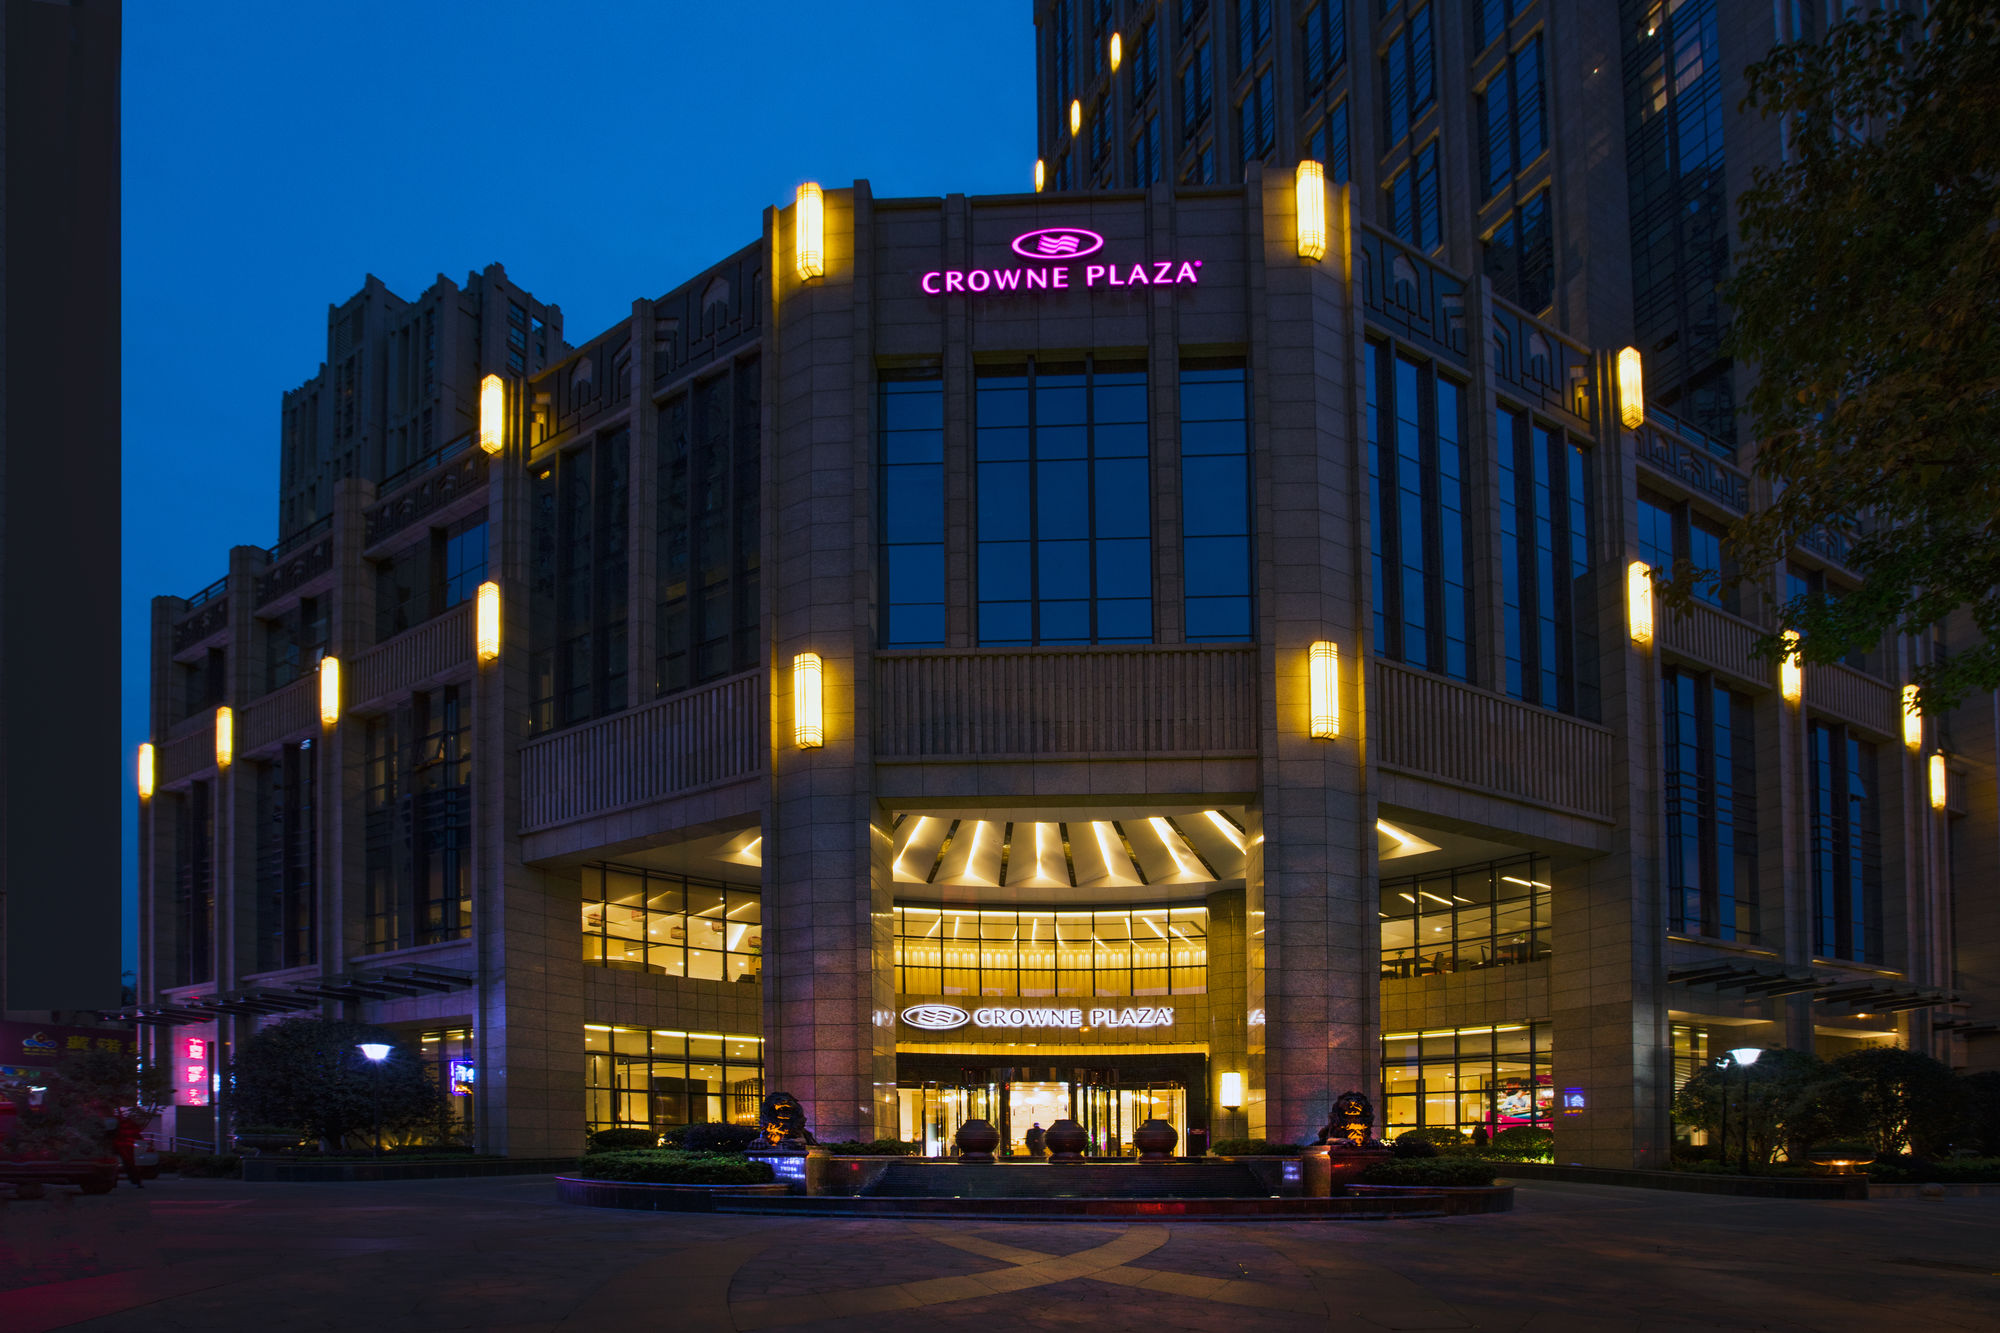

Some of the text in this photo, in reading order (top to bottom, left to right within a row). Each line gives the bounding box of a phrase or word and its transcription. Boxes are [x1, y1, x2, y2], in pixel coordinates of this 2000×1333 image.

[921, 260, 1199, 294] CROWNE PLAZA
[975, 1006, 1172, 1027] CROWNE PLAZA
